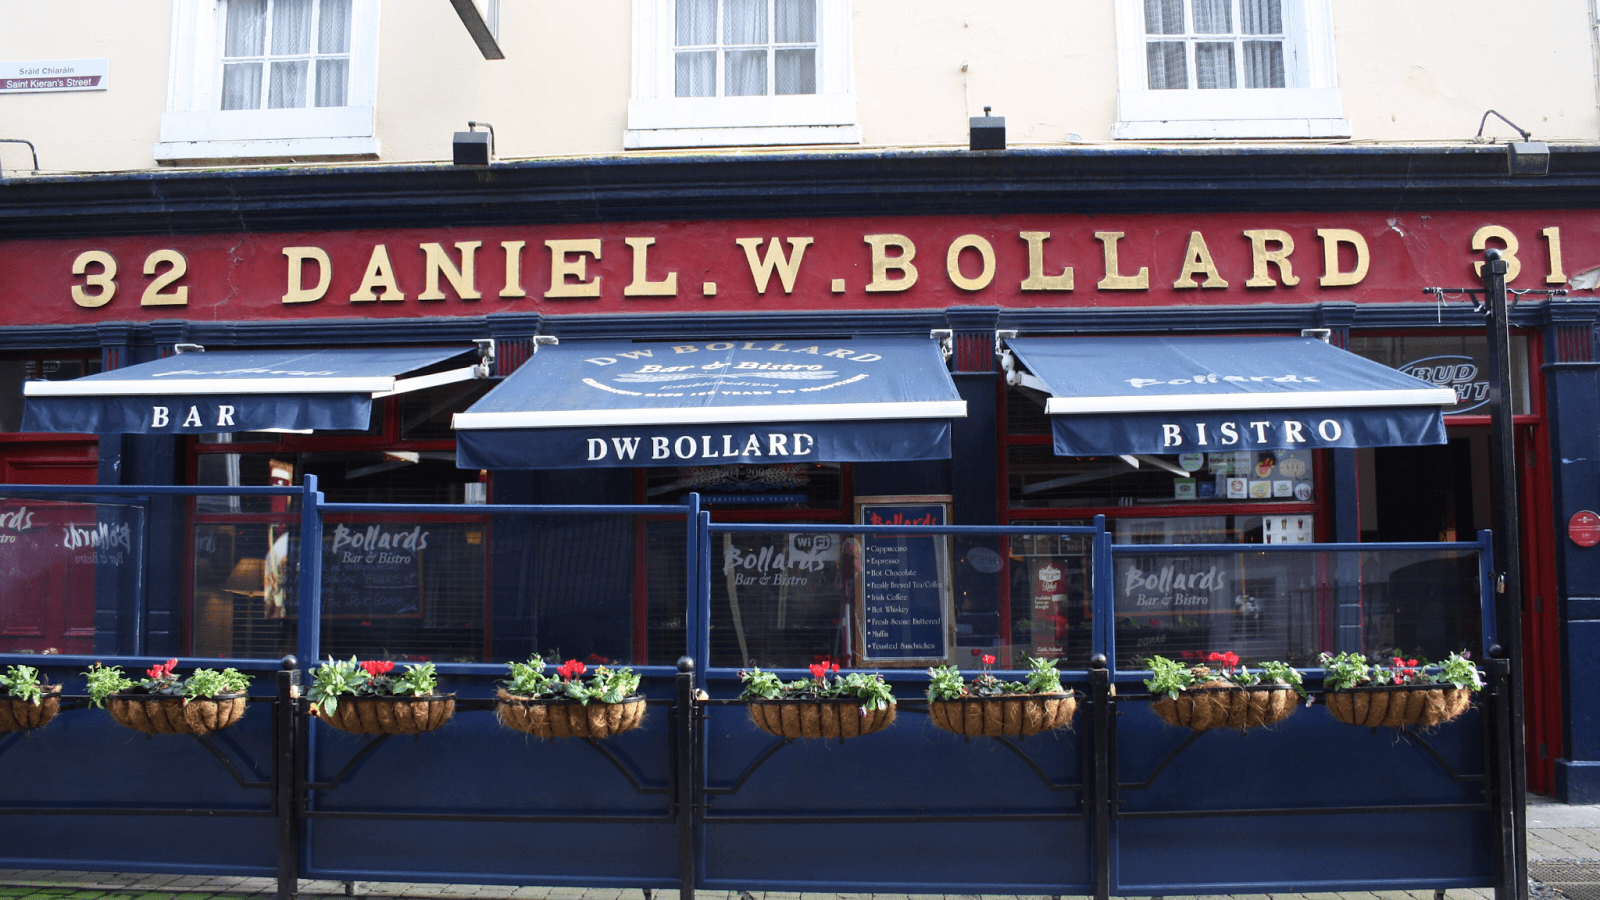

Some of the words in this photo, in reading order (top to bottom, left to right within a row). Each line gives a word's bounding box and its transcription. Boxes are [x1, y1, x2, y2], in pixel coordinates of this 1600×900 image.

[42, 67, 74, 75] Chiaráin
[6, 79, 28, 89] Saint
[30, 78, 64, 88] Kieran's
[66, 78, 92, 87] Street
[1471, 224, 1566, 284] 31
[72, 248, 188, 307] 32
[585, 349, 653, 366] DW
[670, 342, 882, 363] BOLLARD
[635, 363, 696, 374] Bar
[701, 361, 732, 371] &
[733, 361, 823, 372] Bistro
[1411, 364, 1478, 384] BUD
[1124, 374, 1321, 389] Bollards
[151, 405, 235, 428] BAR
[1162, 419, 1342, 447] BISTRO
[587, 437, 641, 461] DW
[651, 433, 815, 461] BOLLARD
[332, 523, 430, 554] Bollards
[342, 552, 364, 564] Bar
[365, 550, 377, 564] &
[378, 551, 411, 565] Bistro
[723, 544, 825, 576] Bollards
[871, 557, 900, 567] Espresso
[734, 572, 757, 585] Bar
[758, 571, 772, 586] &
[772, 572, 808, 586] Bistro
[871, 569, 883, 577] Hot
[884, 568, 917, 577] Chocolate
[1124, 565, 1226, 597] Bollards
[886, 592, 908, 601] Coffee
[1136, 593, 1159, 606] Bar
[1160, 592, 1173, 605] &
[1174, 593, 1209, 606] Bistro
[872, 642, 898, 650] Toasted
